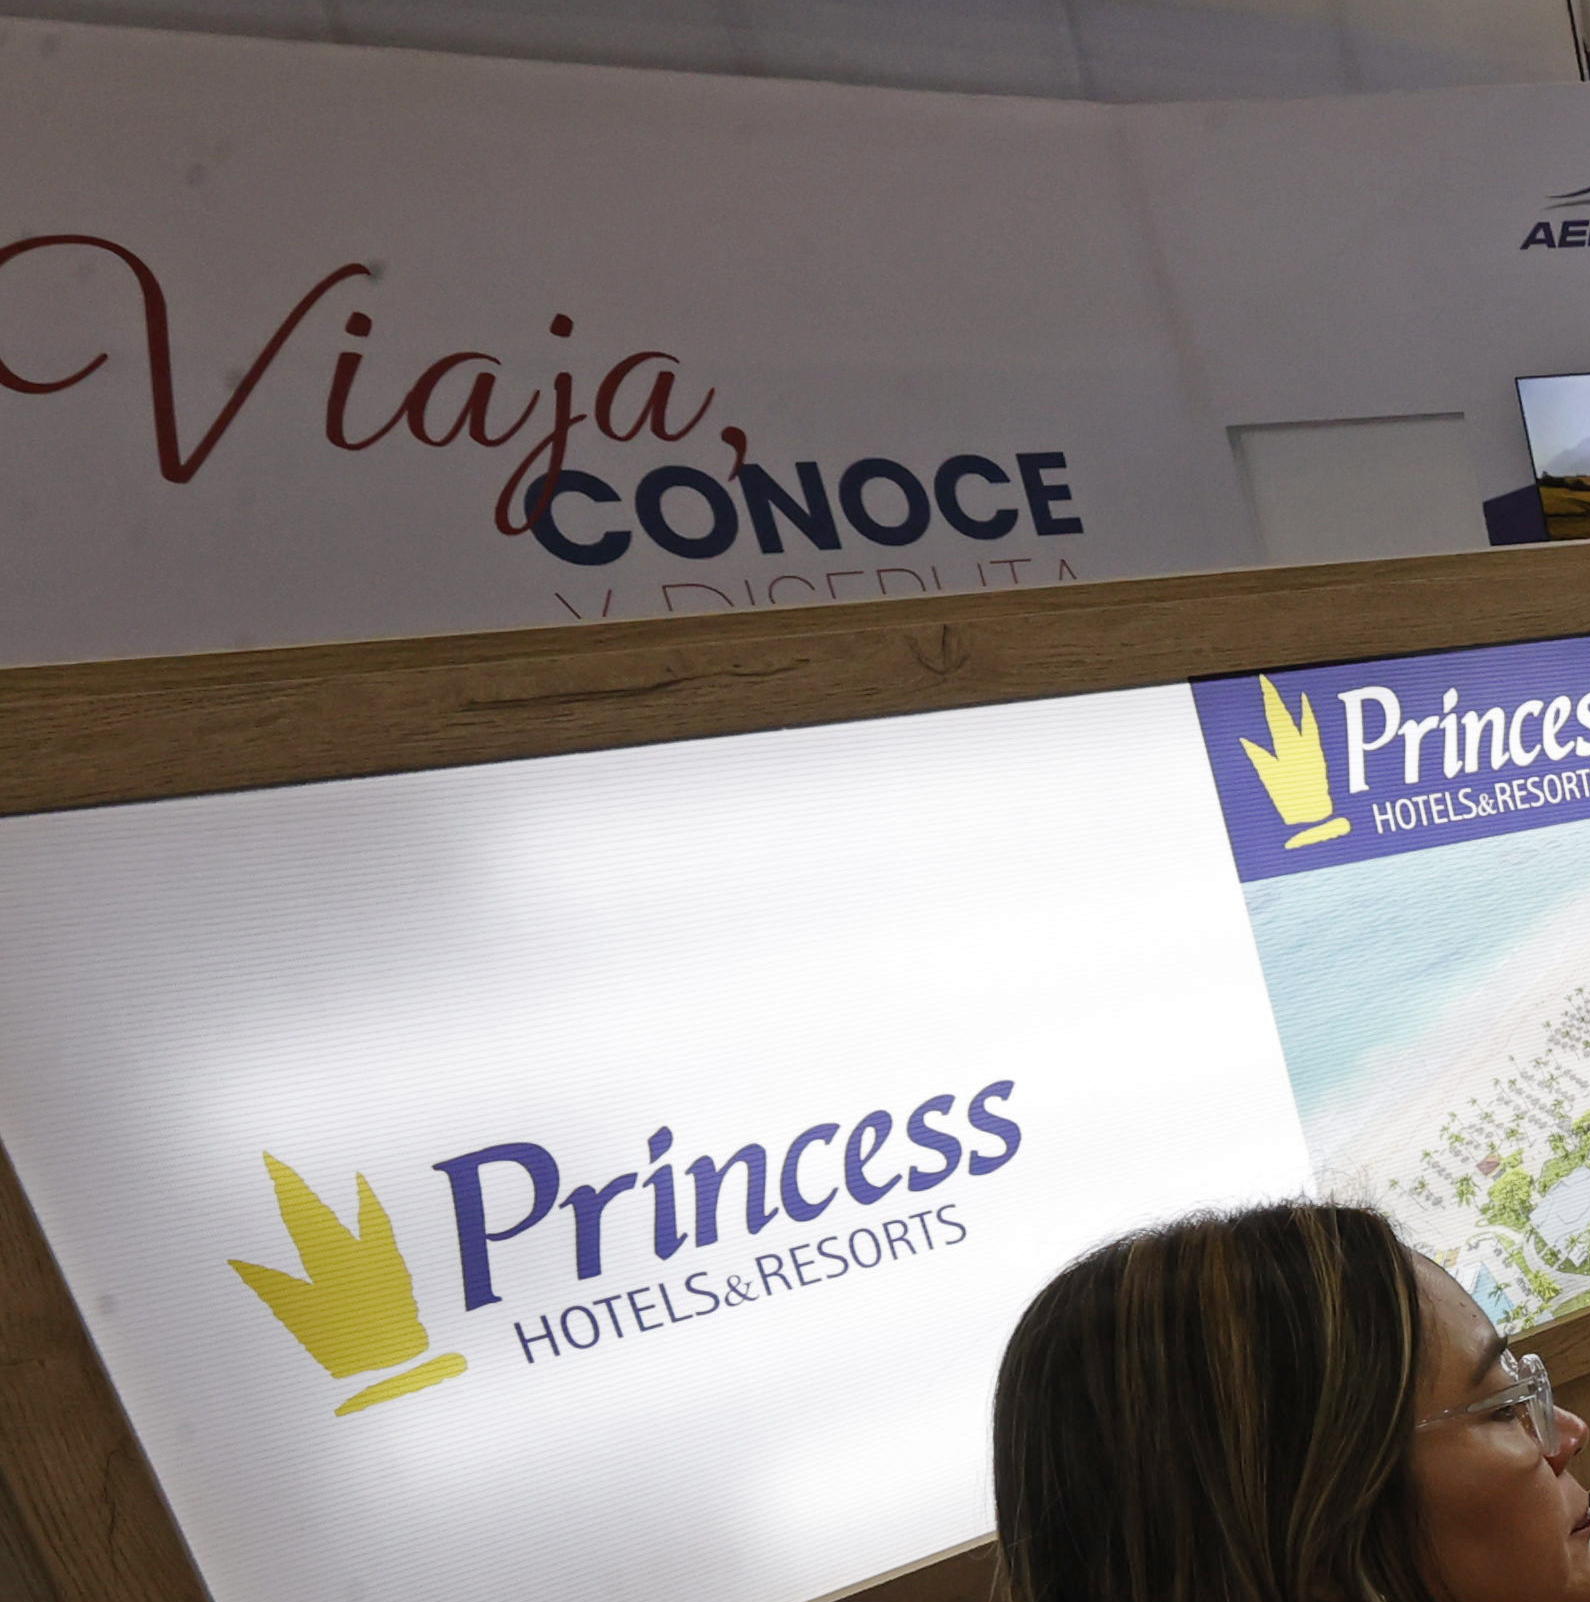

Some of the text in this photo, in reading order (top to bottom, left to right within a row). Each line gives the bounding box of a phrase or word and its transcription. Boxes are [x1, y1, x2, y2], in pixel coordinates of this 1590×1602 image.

[0, 233, 748, 537] Viaja,
[524, 451, 1084, 566] CONOCE
[431, 1078, 1023, 1312] Princess
